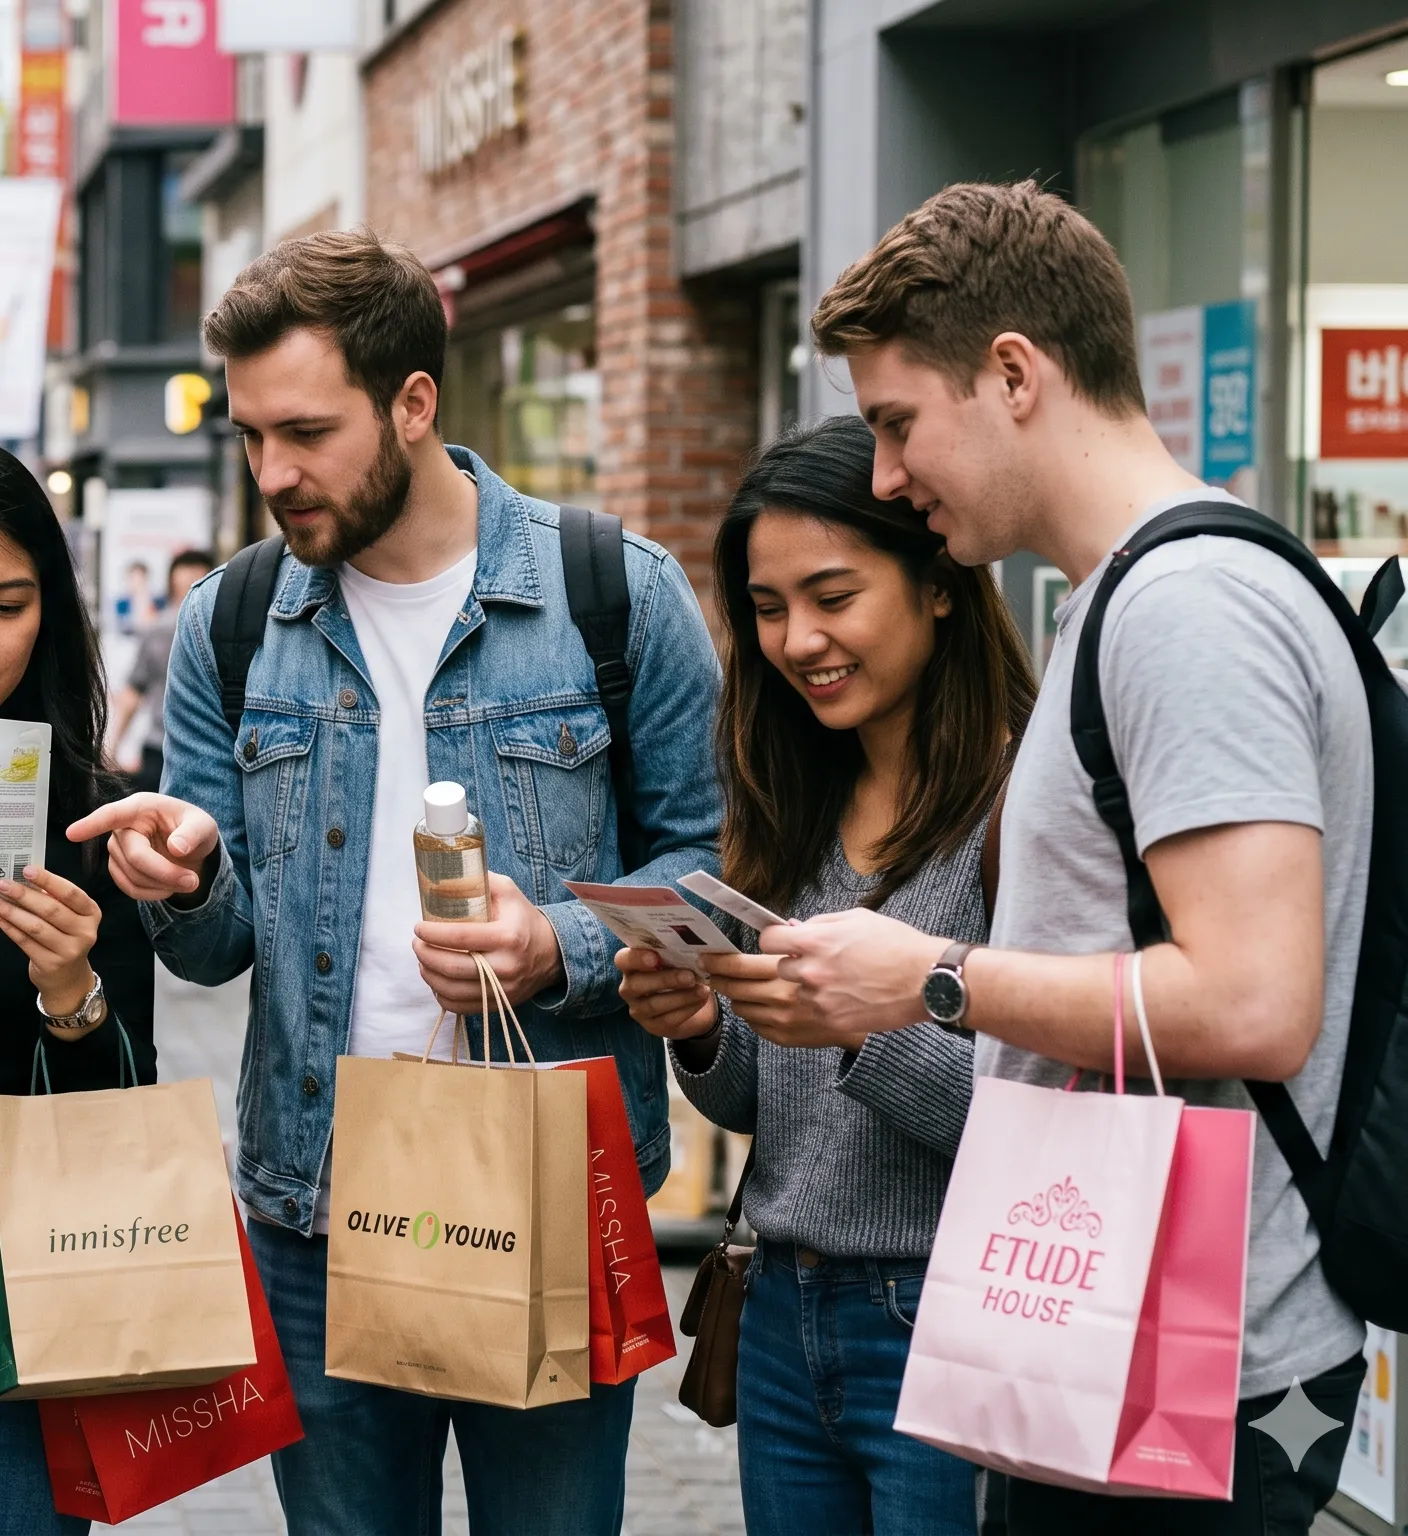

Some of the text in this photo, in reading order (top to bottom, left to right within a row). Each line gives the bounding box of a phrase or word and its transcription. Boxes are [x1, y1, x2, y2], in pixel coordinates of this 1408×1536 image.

[1346, 345, 1408, 407] 버
[48, 1216, 190, 1254] innisfree
[347, 1210, 411, 1238] OLIVE
[444, 1223, 517, 1253] YOUNG
[591, 1148, 631, 1295] MISSHA
[979, 1232, 1106, 1291] ETUDE
[982, 1285, 1074, 1326] HOUSE
[125, 1376, 265, 1459] MISSHA
